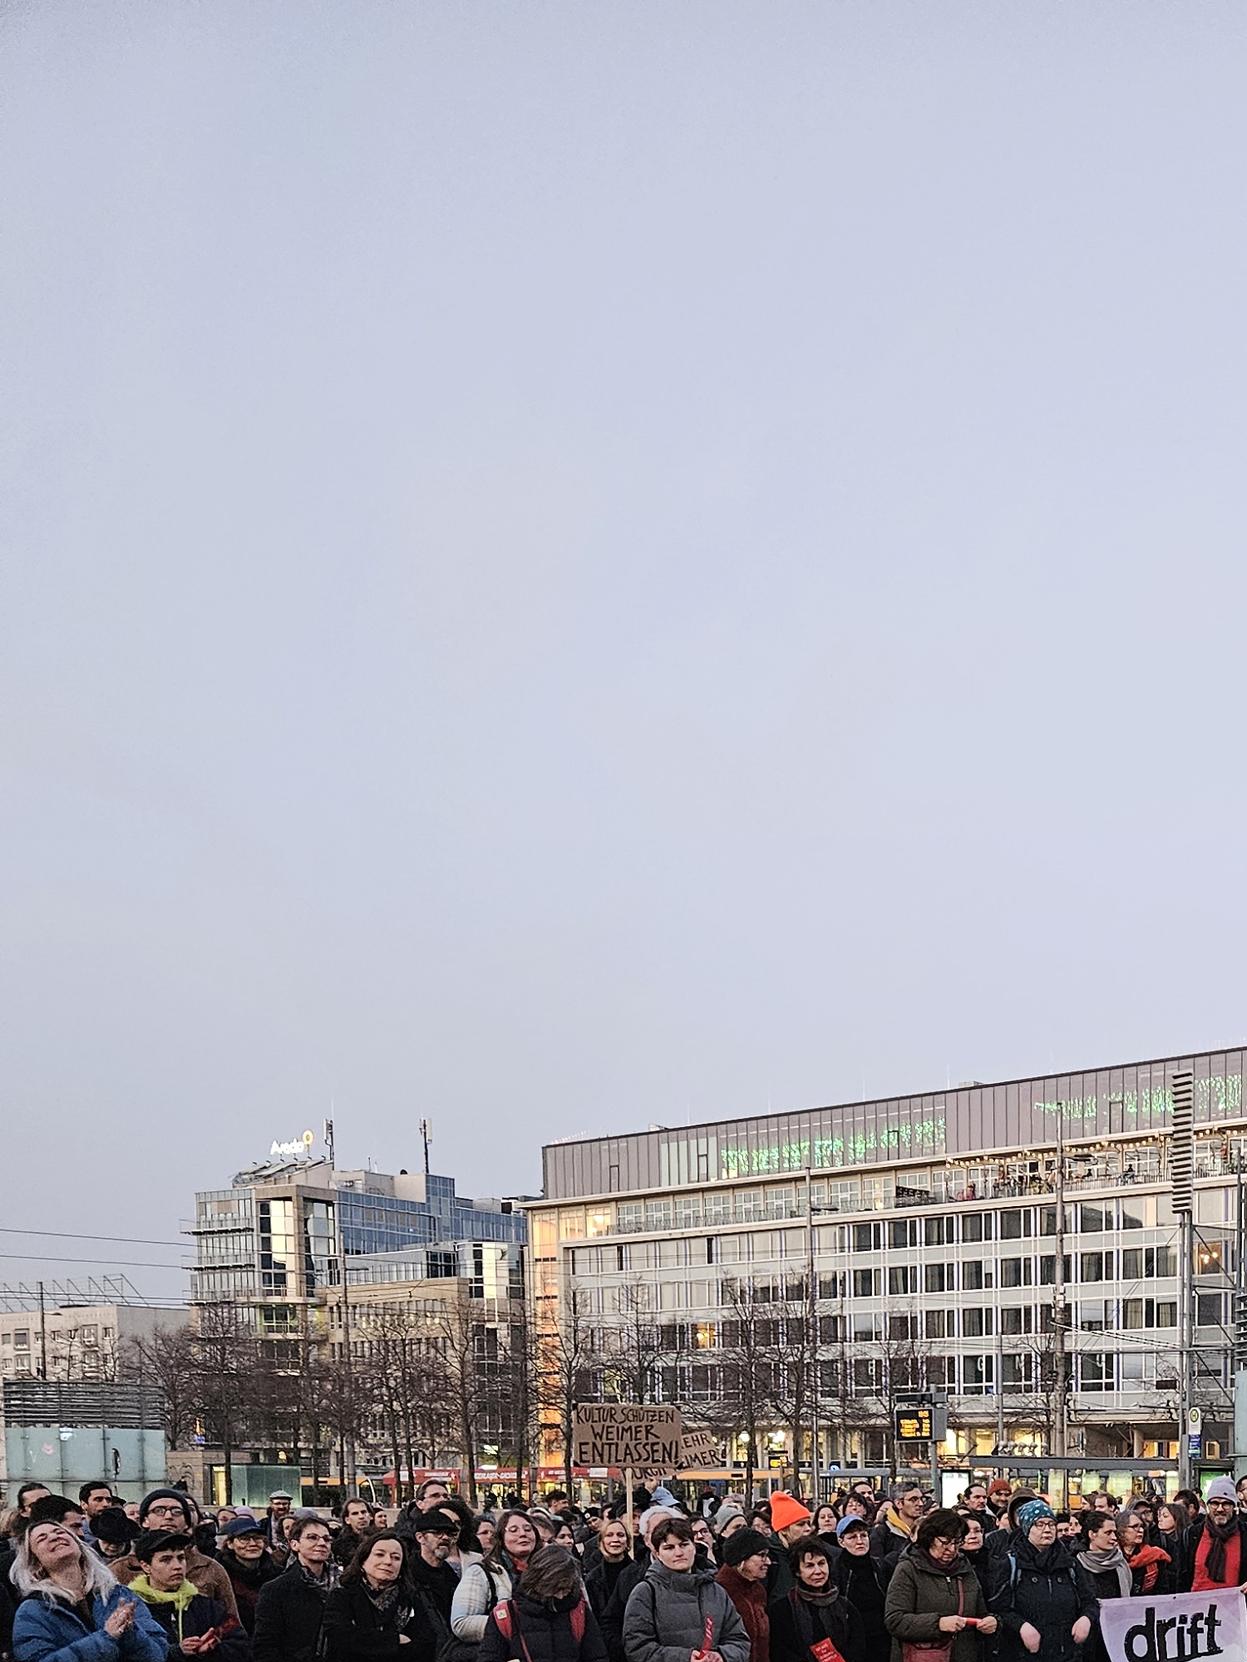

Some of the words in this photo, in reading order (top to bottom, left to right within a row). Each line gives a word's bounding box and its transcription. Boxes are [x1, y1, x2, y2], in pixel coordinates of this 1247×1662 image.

[576, 1407, 616, 1424] KULTUR
[618, 1407, 675, 1424] SCHÜTZEN
[591, 1424, 660, 1441] WEIMER
[681, 1433, 710, 1449] EHR
[578, 1440, 680, 1465] ENTLASSEN!
[681, 1450, 721, 1468] IMER
